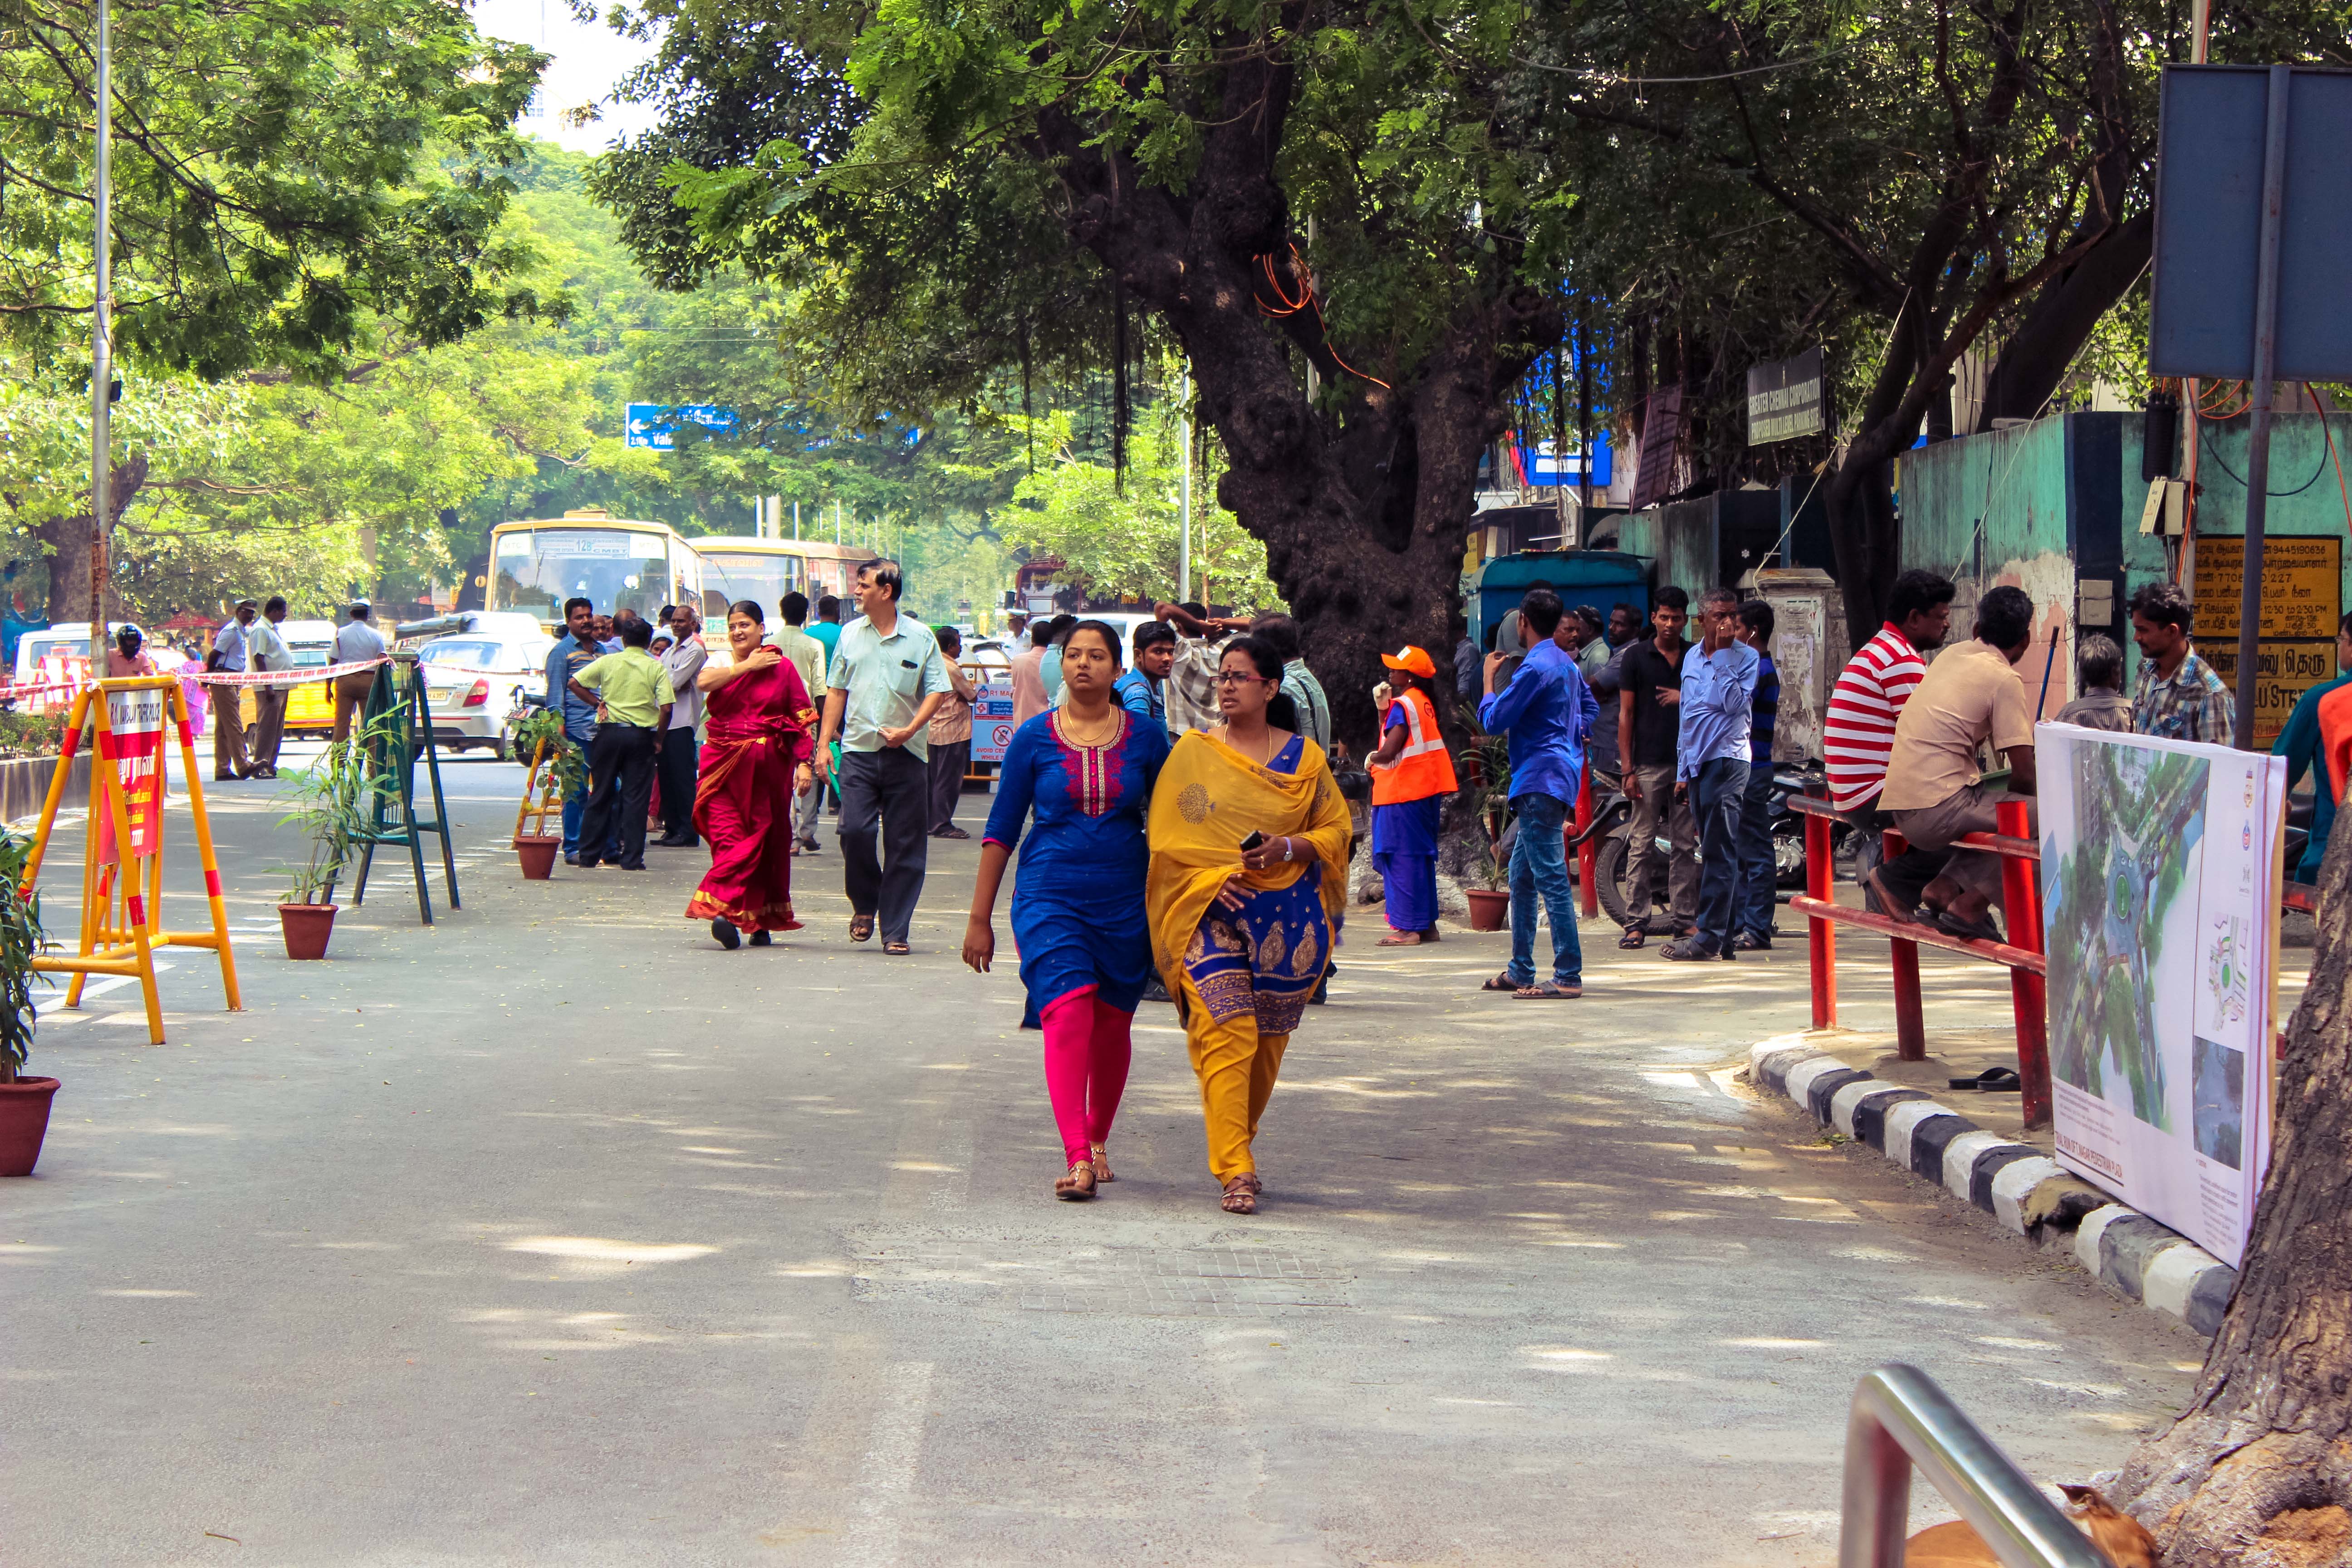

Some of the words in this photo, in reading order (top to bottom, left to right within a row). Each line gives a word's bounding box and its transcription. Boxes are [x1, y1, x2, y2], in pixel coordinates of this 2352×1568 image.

[1749, 392, 1769, 417] GREATER
[1769, 387, 1789, 412] CHENNAI
[1789, 377, 1820, 407] CORPORATION
[1751, 418, 1770, 441] PROPOSED
[1794, 409, 1810, 431] PARKING
[1810, 407, 1819, 429] SITE
[2285, 649, 2325, 679] தெரு
